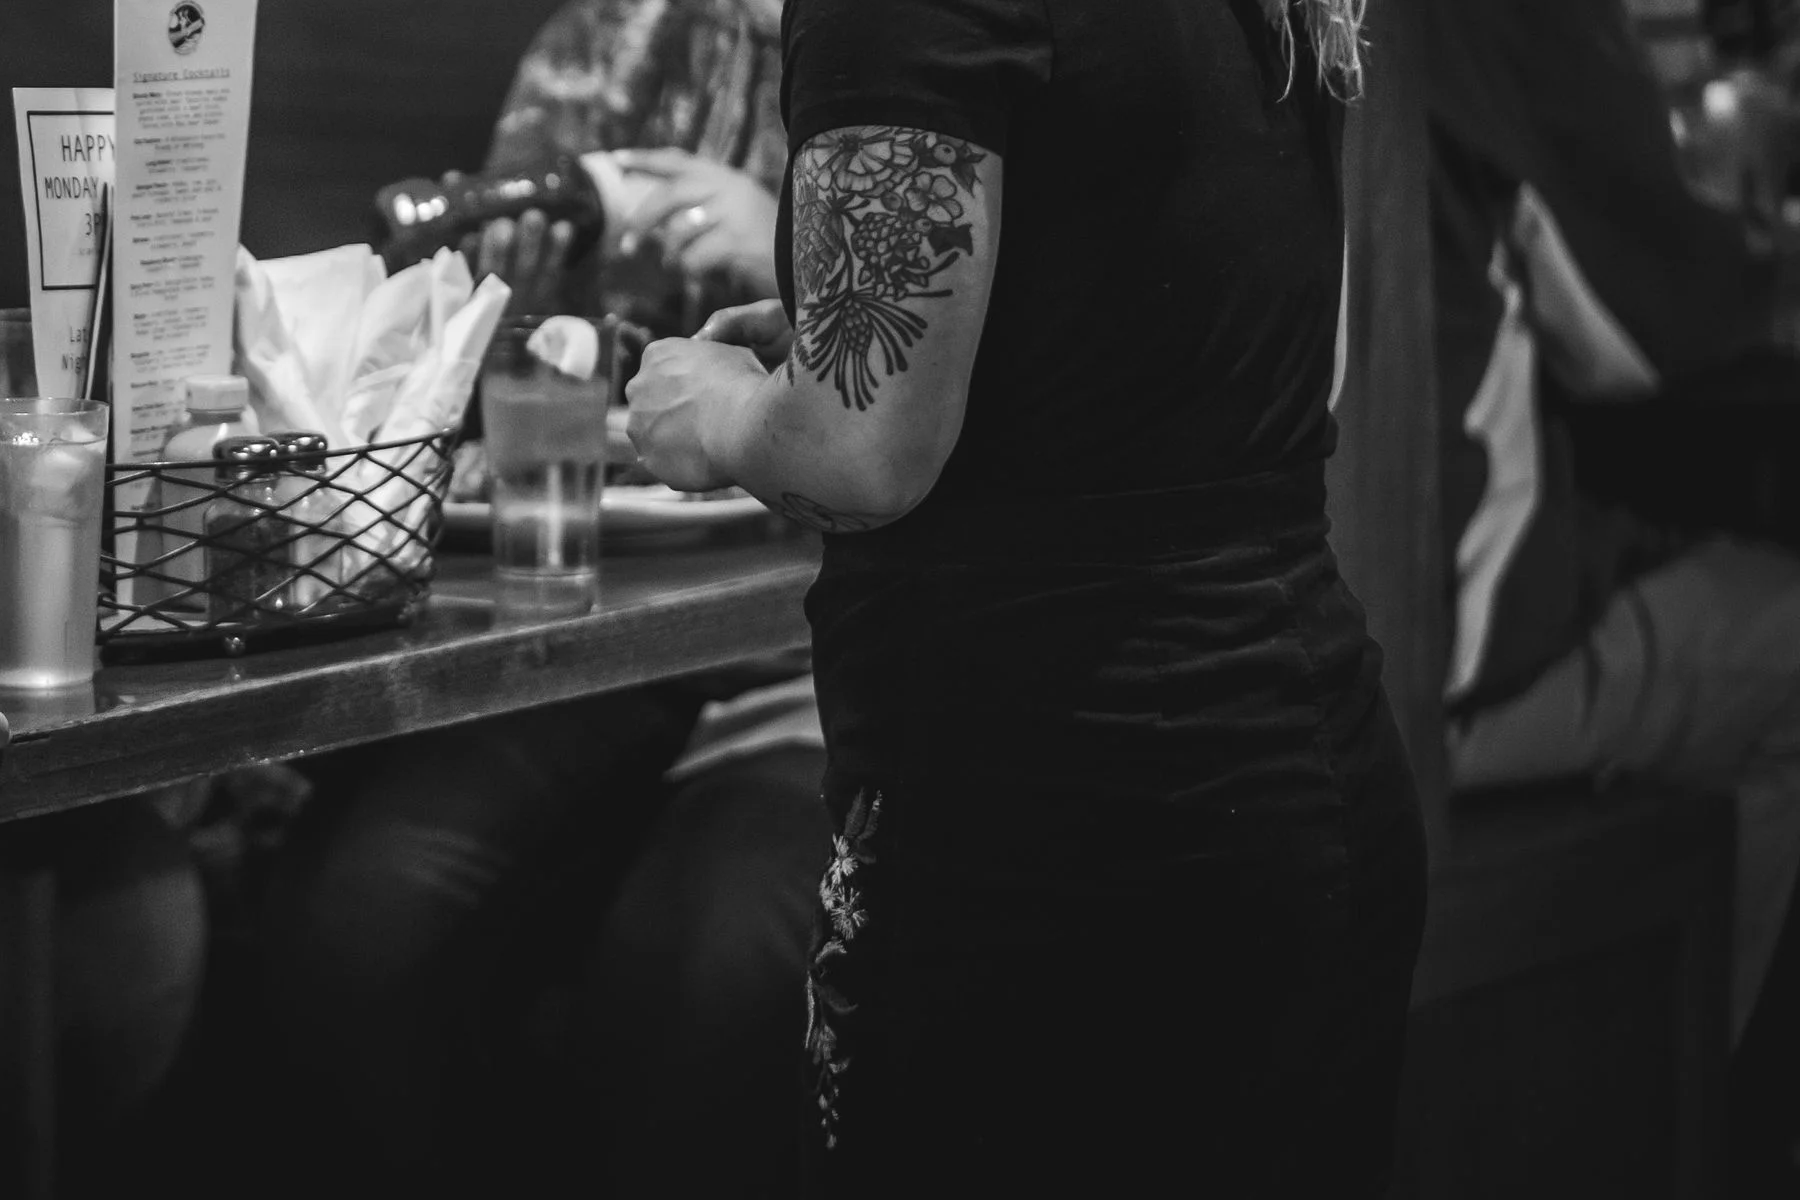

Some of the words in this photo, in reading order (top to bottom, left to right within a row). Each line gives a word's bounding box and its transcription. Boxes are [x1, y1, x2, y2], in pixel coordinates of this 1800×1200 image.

[44, 176, 99, 199] MONDAY
[84, 212, 103, 237] 3P
[70, 326, 88, 343] Lat
